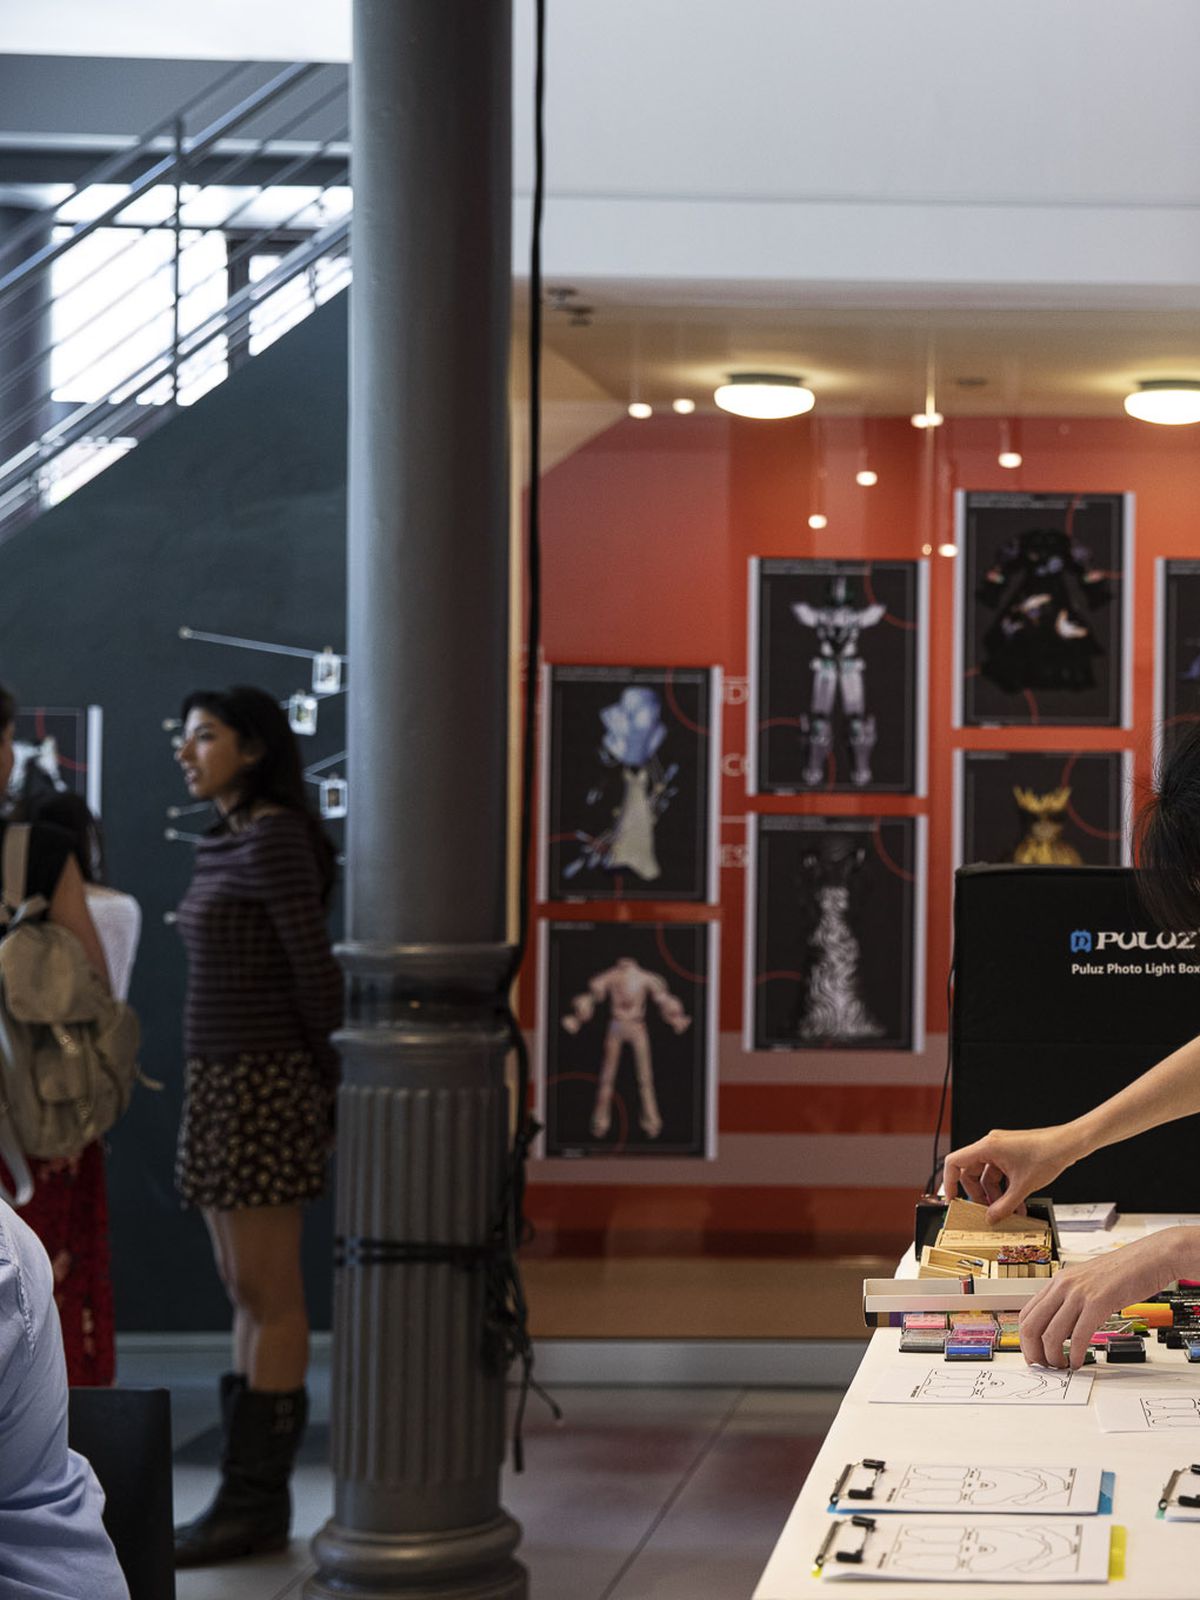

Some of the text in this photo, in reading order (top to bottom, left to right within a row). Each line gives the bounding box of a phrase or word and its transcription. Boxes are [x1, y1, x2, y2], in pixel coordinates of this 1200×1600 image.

[1096, 931, 1197, 950] PULUZ
[1072, 963, 1200, 976] Puluz Photo Light Box
